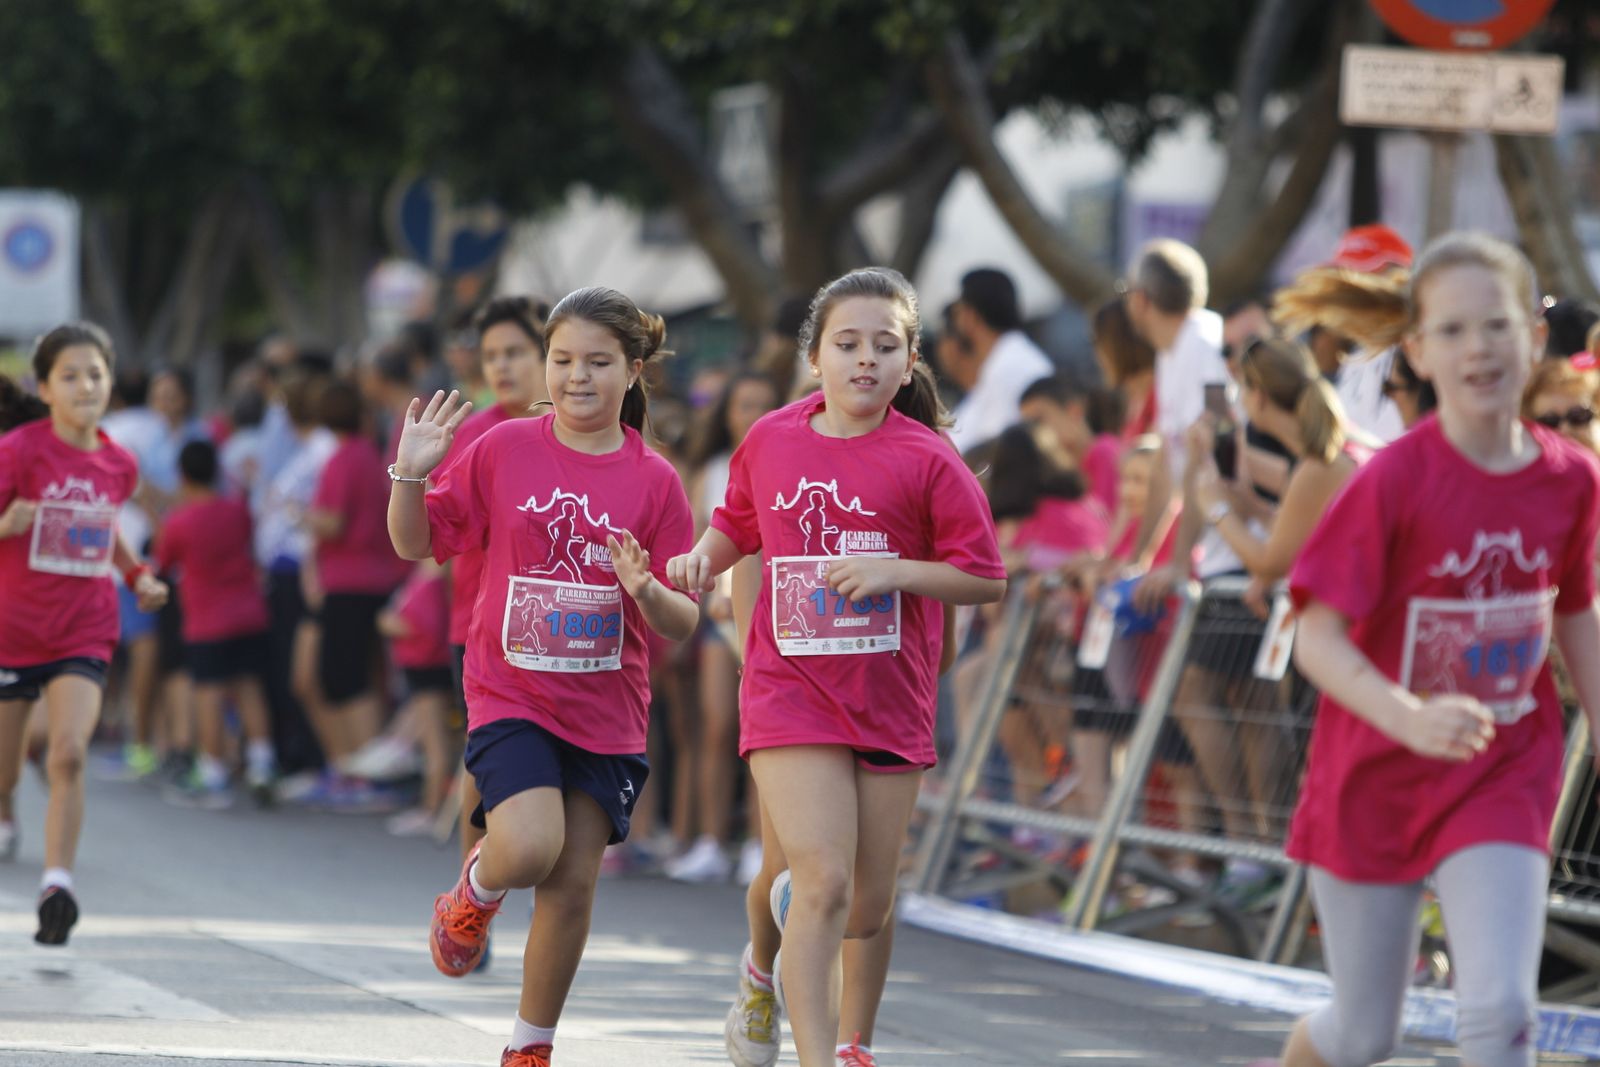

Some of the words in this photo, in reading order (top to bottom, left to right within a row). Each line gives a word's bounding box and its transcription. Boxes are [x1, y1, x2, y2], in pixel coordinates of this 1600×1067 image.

[834, 530, 847, 558] 4
[847, 531, 888, 542] CARRERA
[847, 541, 889, 550] SOLIDARIA
[580, 542, 592, 566] 4
[560, 588, 592, 600] CARRERA
[546, 611, 620, 638] 1802
[833, 617, 870, 628] CARMEN
[567, 640, 595, 649] AFRICA
